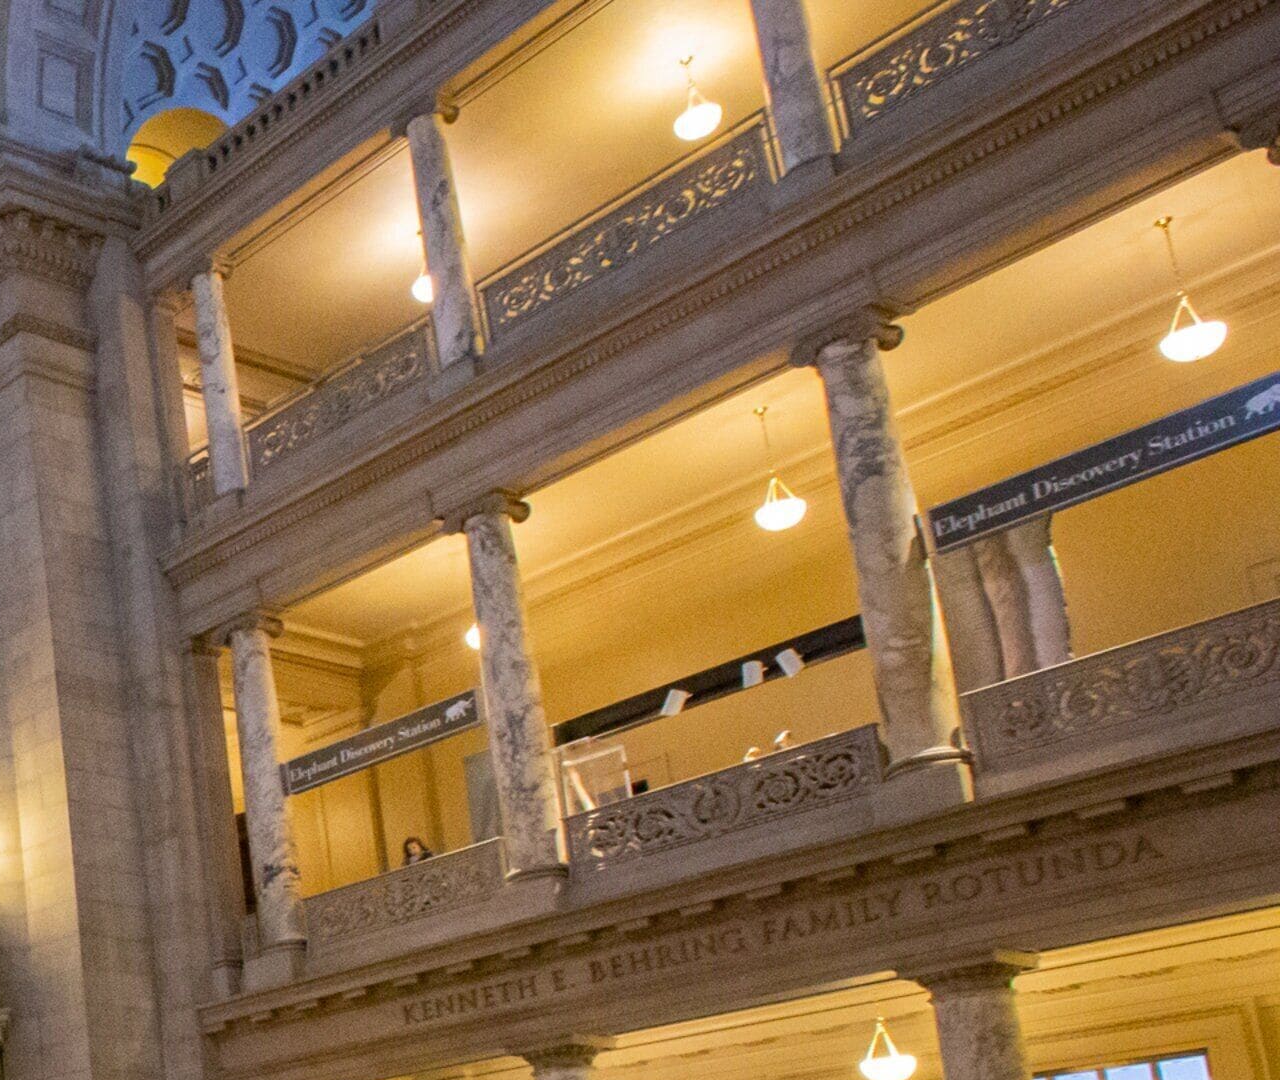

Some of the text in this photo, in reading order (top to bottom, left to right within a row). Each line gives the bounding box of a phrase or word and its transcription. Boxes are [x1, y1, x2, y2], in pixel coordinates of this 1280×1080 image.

[934, 413, 1236, 538] Elephant Discovery Station
[290, 718, 440, 782] Elephant Discovery Station
[402, 834, 1165, 1025] KENNETH E. BEHRING FAMILY ROTUNDA
